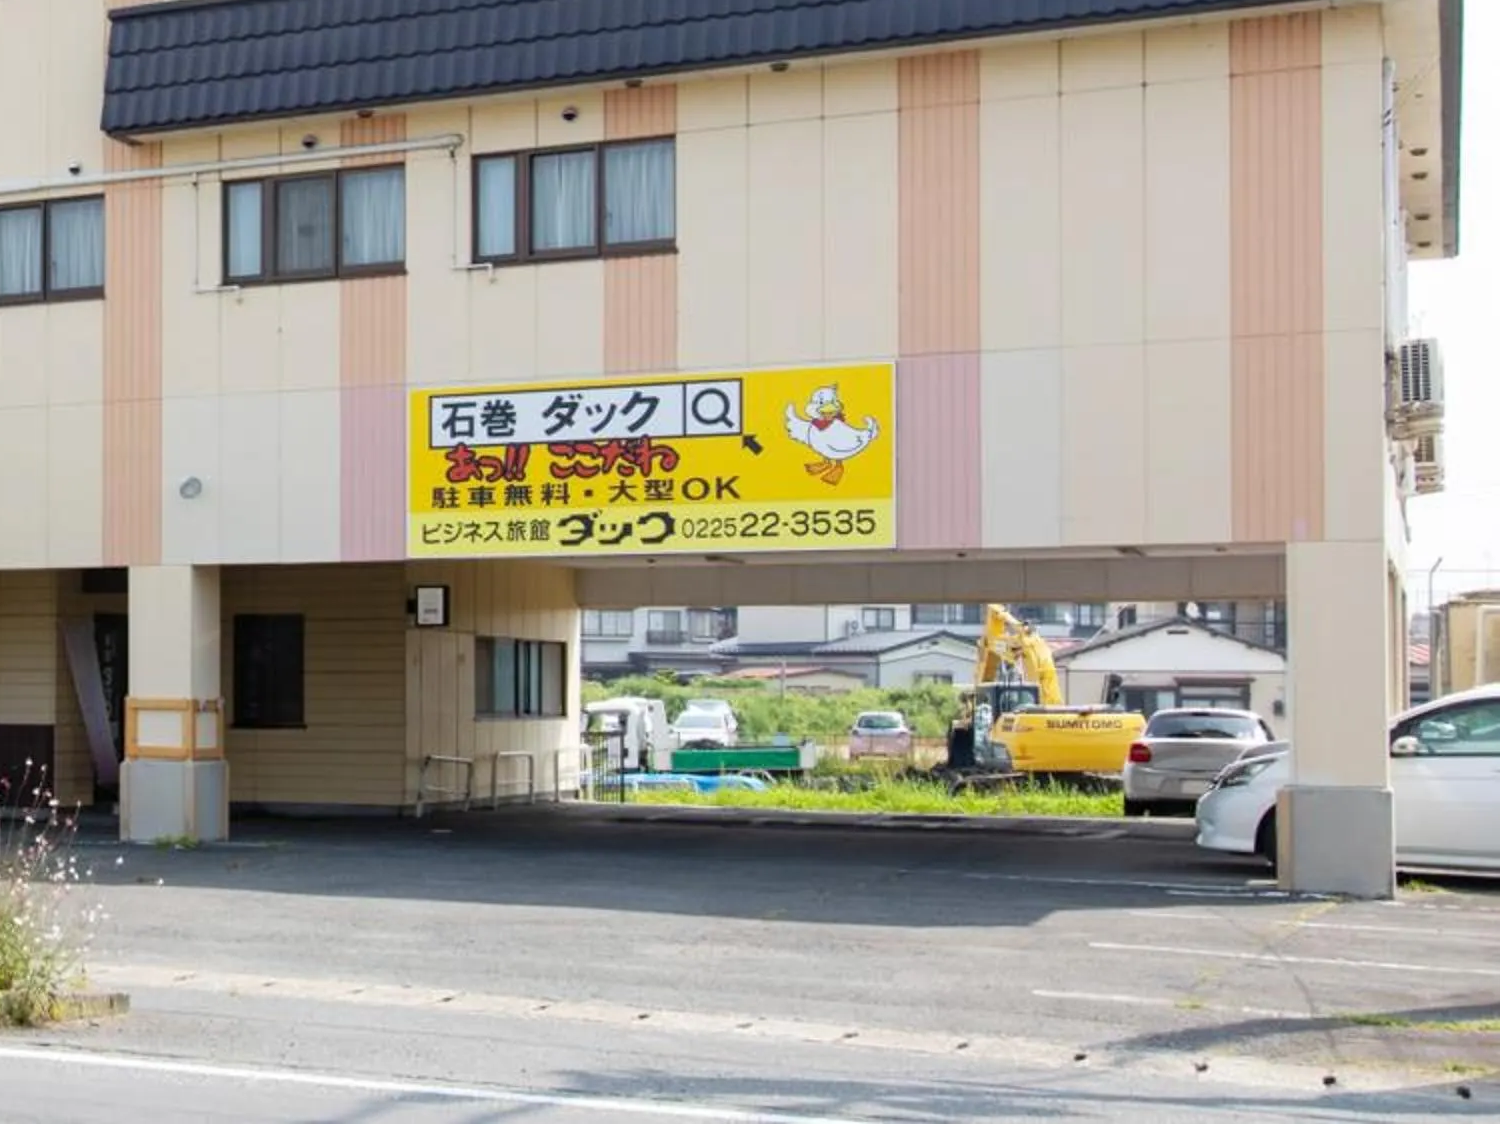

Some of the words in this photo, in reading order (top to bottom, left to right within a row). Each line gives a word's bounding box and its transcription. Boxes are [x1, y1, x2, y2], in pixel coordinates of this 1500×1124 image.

[441, 398, 517, 439] 石巻
[542, 391, 660, 435] ダック
[557, 509, 676, 546] ダック
[1046, 719, 1123, 730] SUMITOMO
